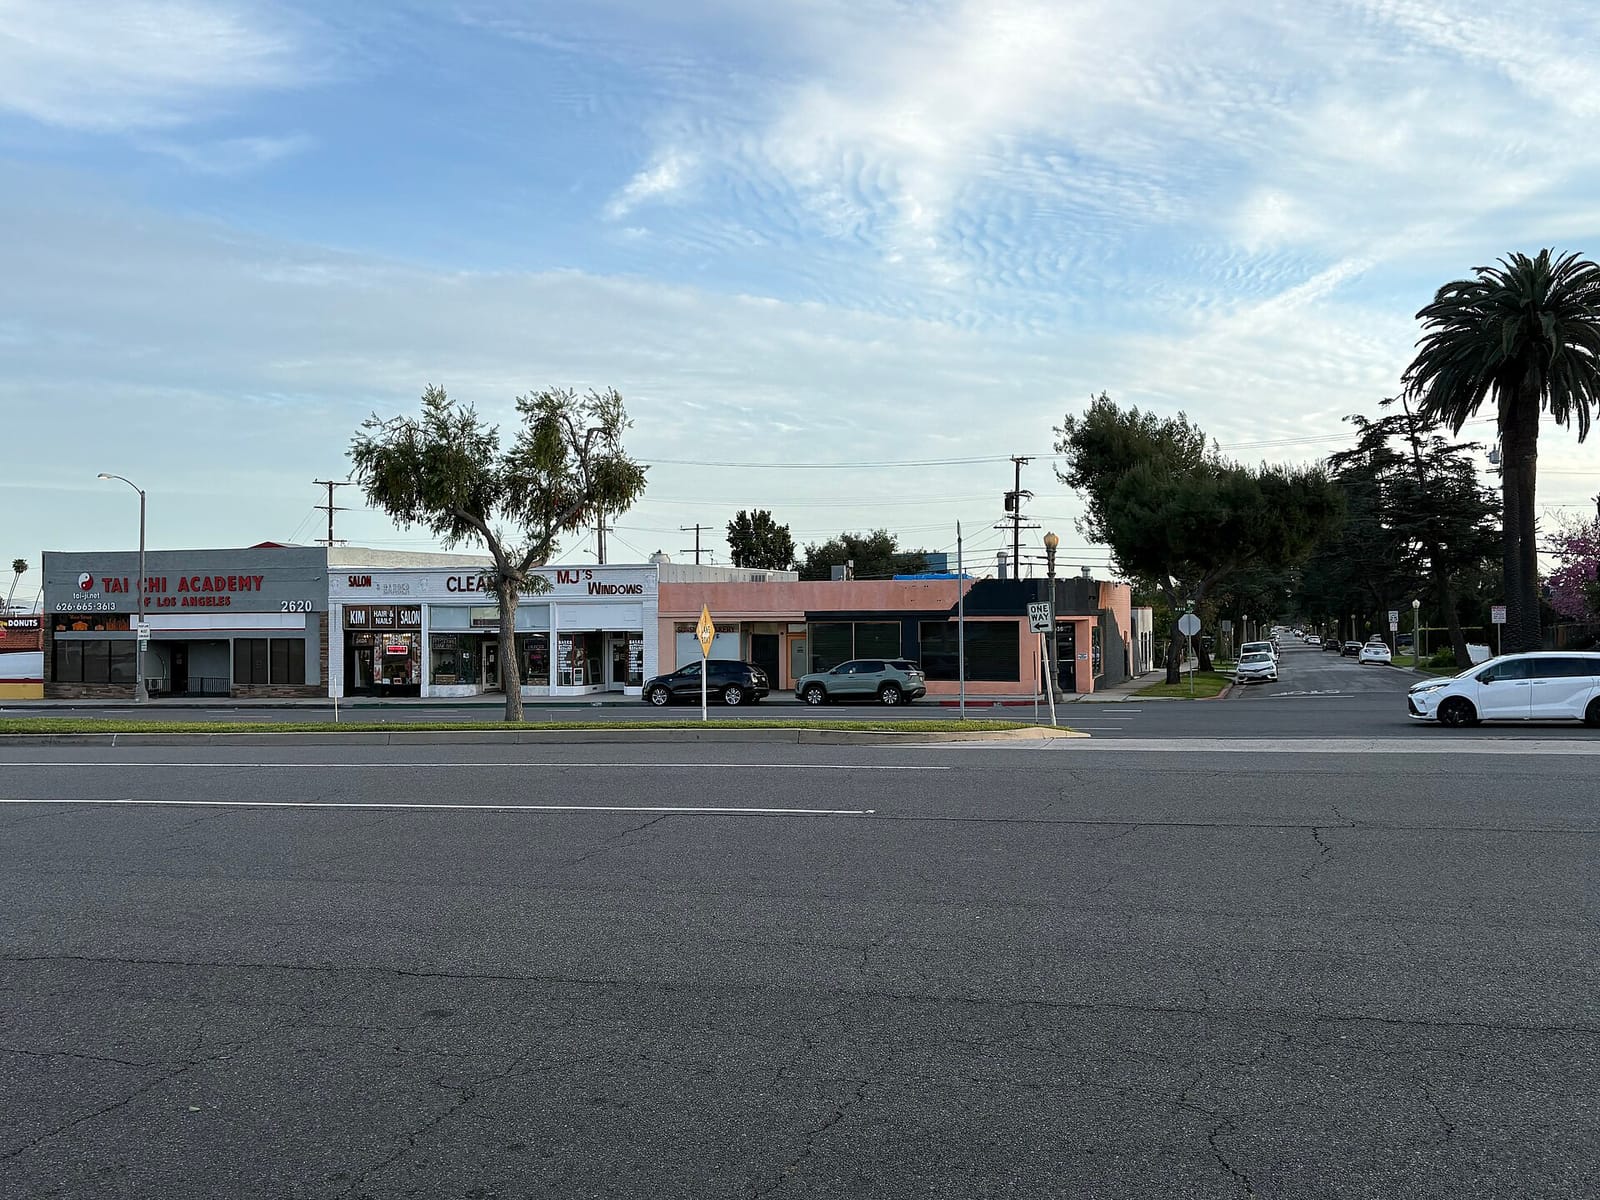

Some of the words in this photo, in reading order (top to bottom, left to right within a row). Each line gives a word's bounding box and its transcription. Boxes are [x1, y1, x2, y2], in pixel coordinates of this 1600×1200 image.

[348, 575, 372, 587] SALON
[557, 569, 593, 584] MJ'S
[102, 577, 129, 593] TAI
[178, 575, 264, 592] ACADEMY
[446, 576, 493, 592] CLEA
[73, 592, 100, 600] tai-ji.net
[157, 597, 176, 607] LOS
[181, 596, 231, 607] ANGELES
[281, 600, 312, 612] 2620
[1030, 605, 1048, 614] ONE
[350, 610, 366, 624] KIM
[373, 610, 387, 618] HAIR
[389, 610, 394, 618] &
[400, 610, 420, 624] SALON
[1031, 613, 1049, 621] WAY
[8, 619, 38, 627] DONUTS
[375, 617, 393, 625] NAILS
